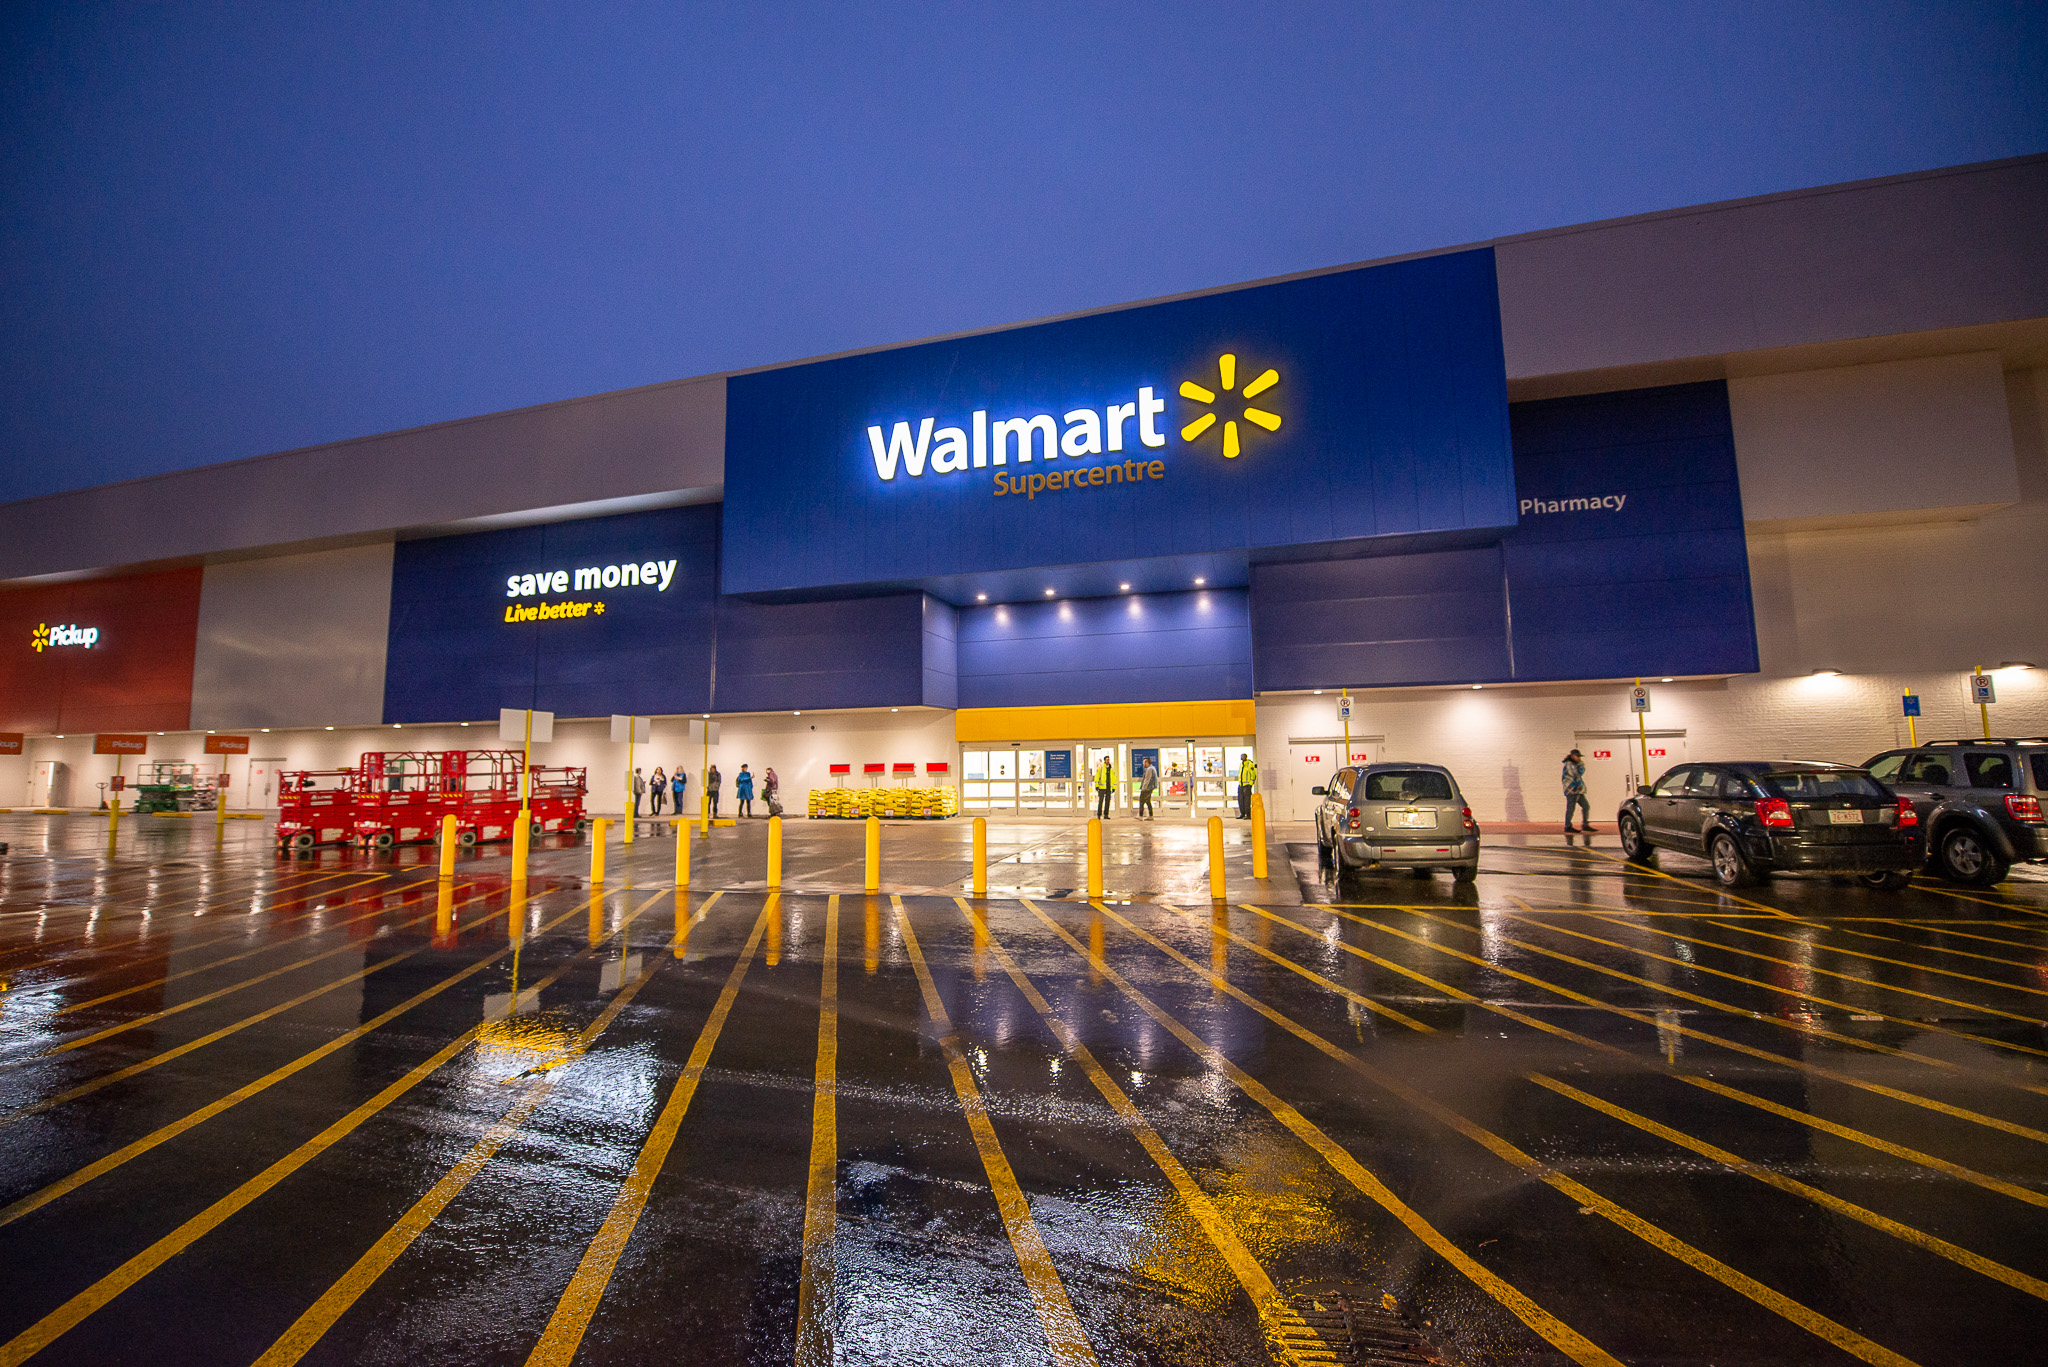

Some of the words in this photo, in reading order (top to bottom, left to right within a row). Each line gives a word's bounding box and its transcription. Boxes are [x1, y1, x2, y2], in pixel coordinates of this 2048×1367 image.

[867, 386, 1166, 480] Walmart
[993, 458, 1165, 500] Supercentre
[1520, 494, 1627, 516] Pharmacy
[506, 569, 570, 598] save
[574, 559, 678, 592] money
[504, 603, 539, 623] Live
[538, 601, 593, 620] better
[49, 624, 99, 649] Pickup
[112, 740, 144, 750] Pickup
[219, 741, 247, 750] Pickup
